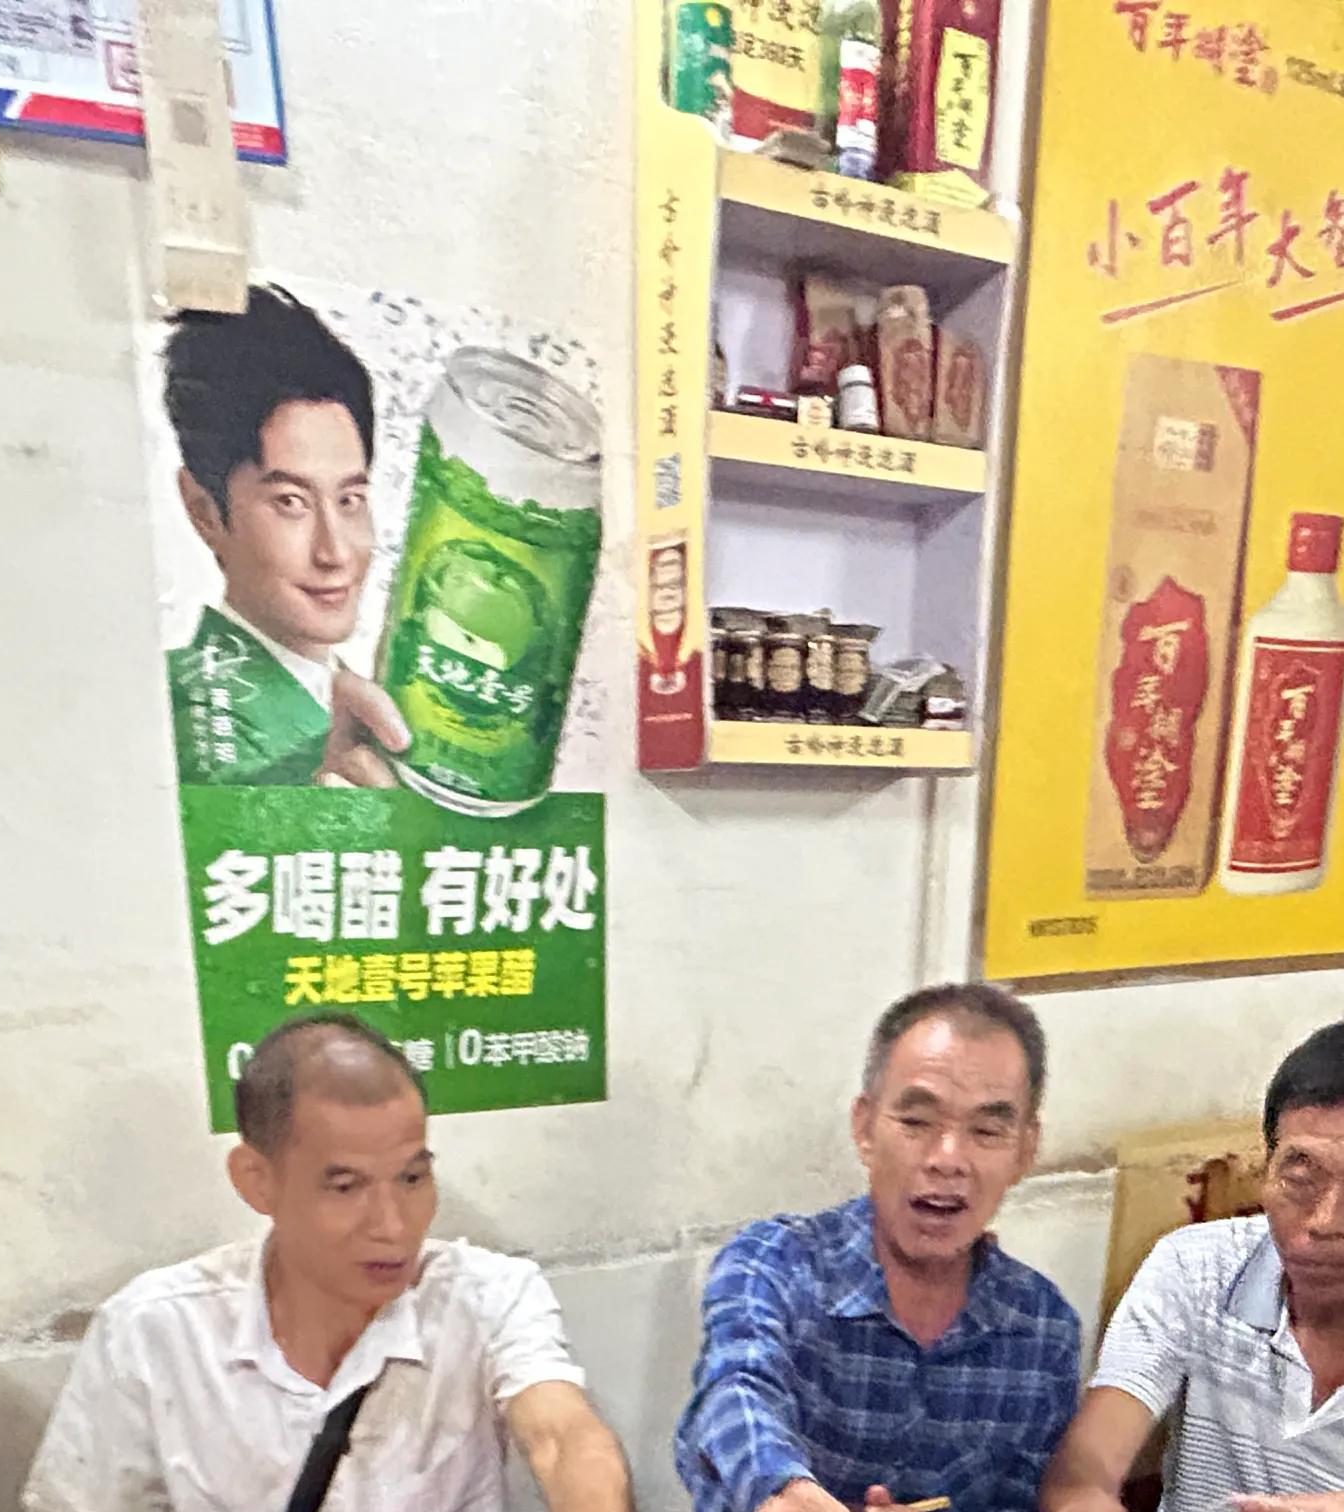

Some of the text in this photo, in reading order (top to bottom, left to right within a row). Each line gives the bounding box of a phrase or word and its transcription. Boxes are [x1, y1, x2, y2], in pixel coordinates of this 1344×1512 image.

[418, 644, 534, 713] 天地壹号
[202, 845, 599, 946] 多喝醋 有好处
[283, 948, 536, 1006] 天地壹号苹果醋
